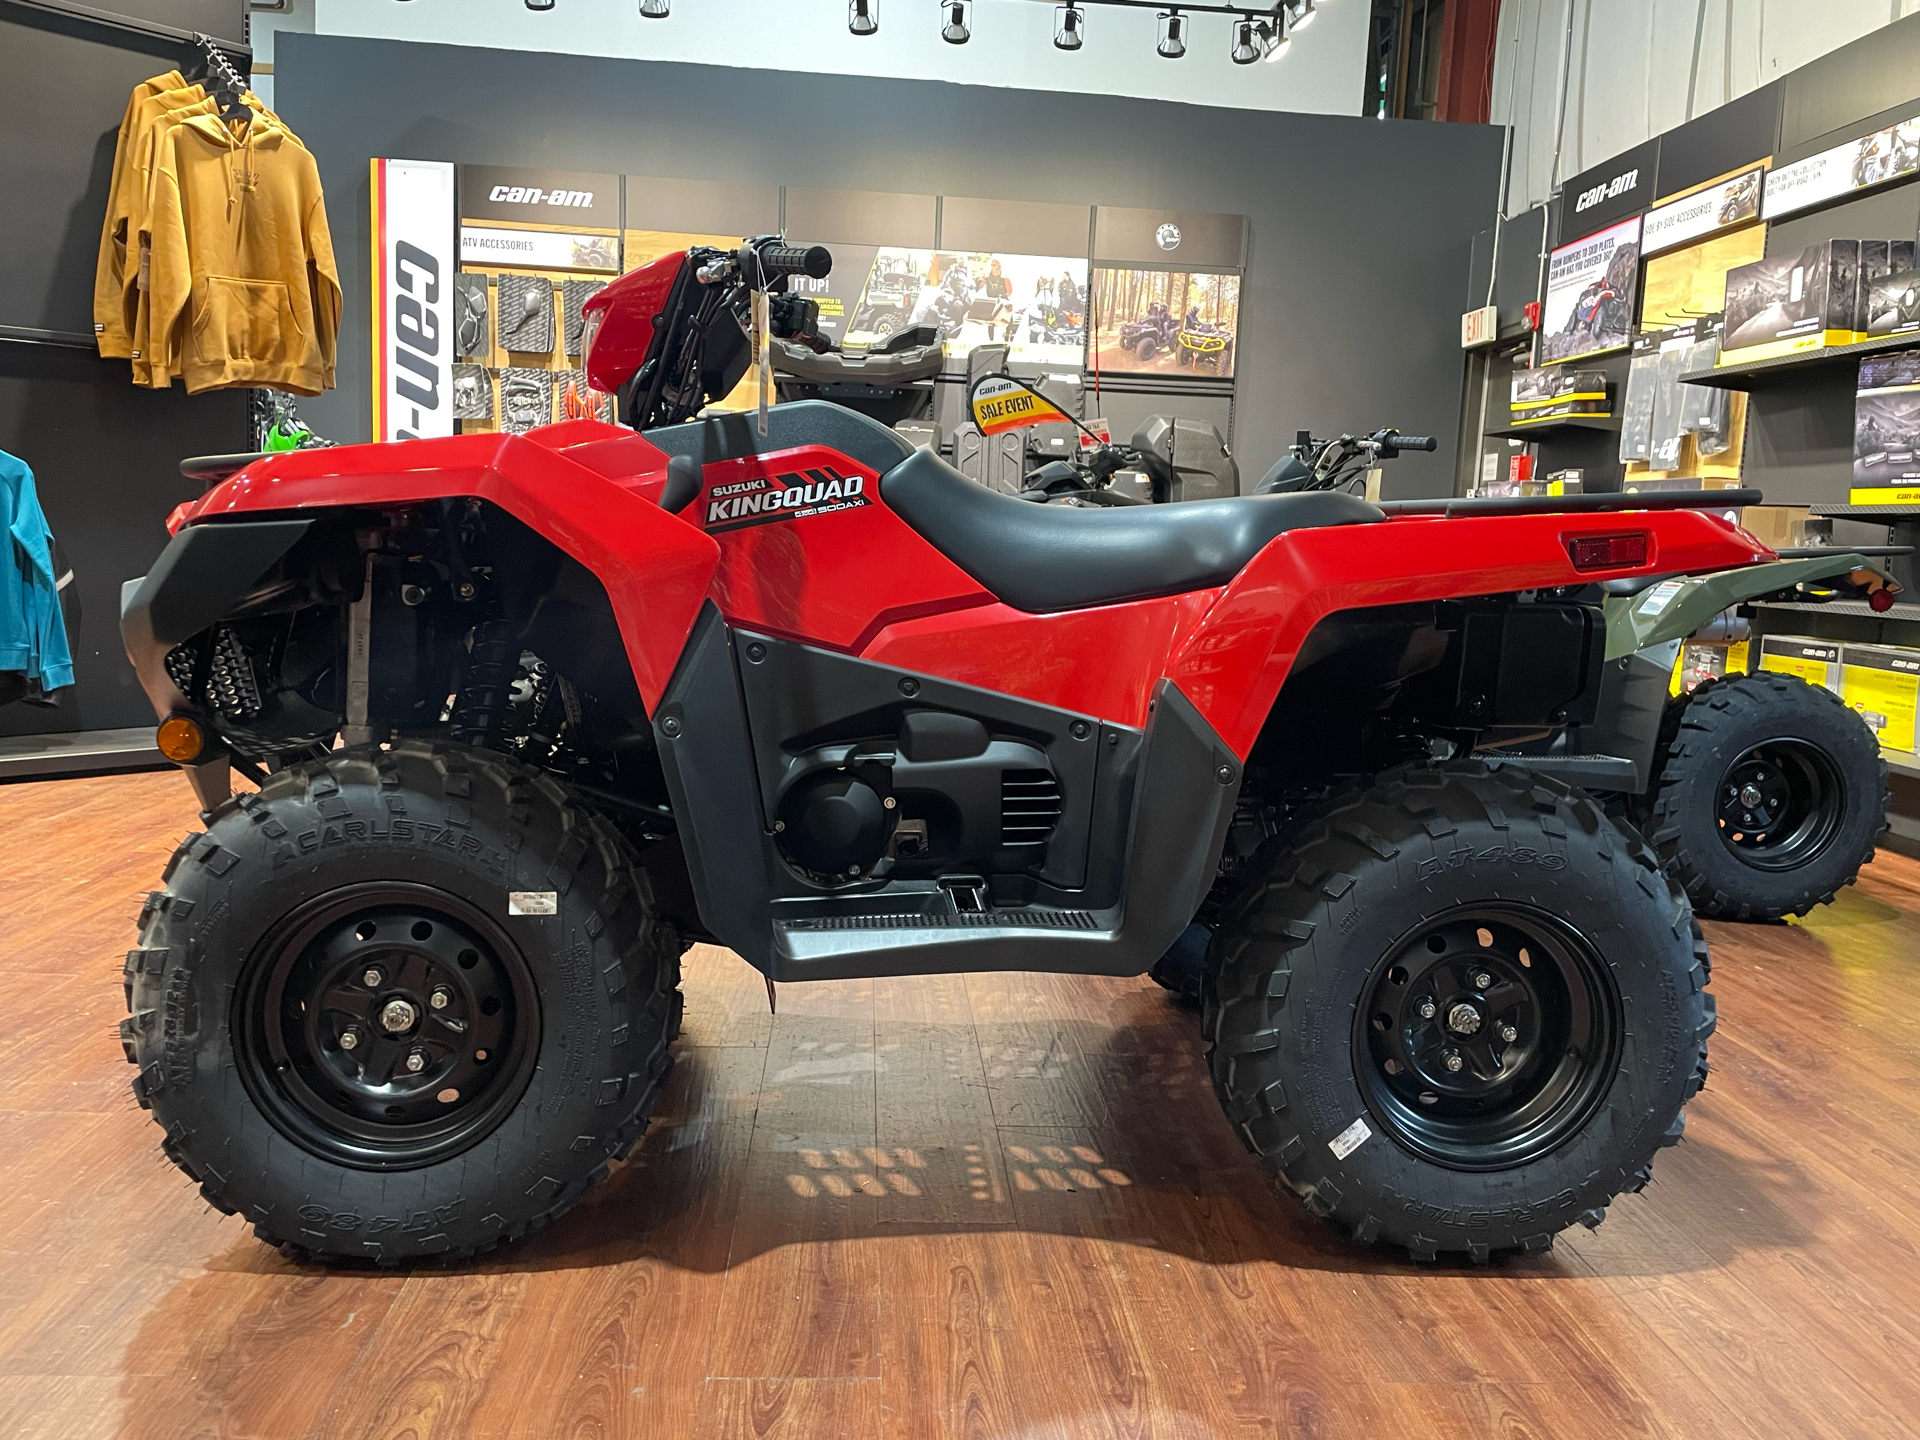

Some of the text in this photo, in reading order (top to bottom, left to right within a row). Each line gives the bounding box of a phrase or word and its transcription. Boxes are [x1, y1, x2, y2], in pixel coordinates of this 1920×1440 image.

[489, 185, 593, 208] can-am
[1575, 168, 1638, 213] can-am
[1645, 201, 1712, 236] SIDE BY SIDE ACCESSORIES
[463, 237, 533, 251] ATV ACCESSORIES
[1552, 257, 1562, 270] FROM
[1563, 250, 1581, 266] BUMPERS
[1588, 243, 1598, 256] SKID
[1550, 267, 1566, 281] CAN-AM
[1566, 263, 1574, 275] HAS
[1575, 260, 1583, 272] YOU
[1584, 253, 1602, 269] COVERED
[795, 277, 830, 292] IT UP!
[1467, 311, 1484, 343] EXIT
[979, 382, 1012, 396] can-am
[980, 395, 1034, 420] SALE EVENT
[708, 475, 864, 522] KINGQUAD
[712, 479, 766, 498] SUZUKI
[1802, 648, 1827, 658] can-am
[296, 818, 488, 860] CARLSTAR
[1403, 1187, 1577, 1230] CARLSTAR
